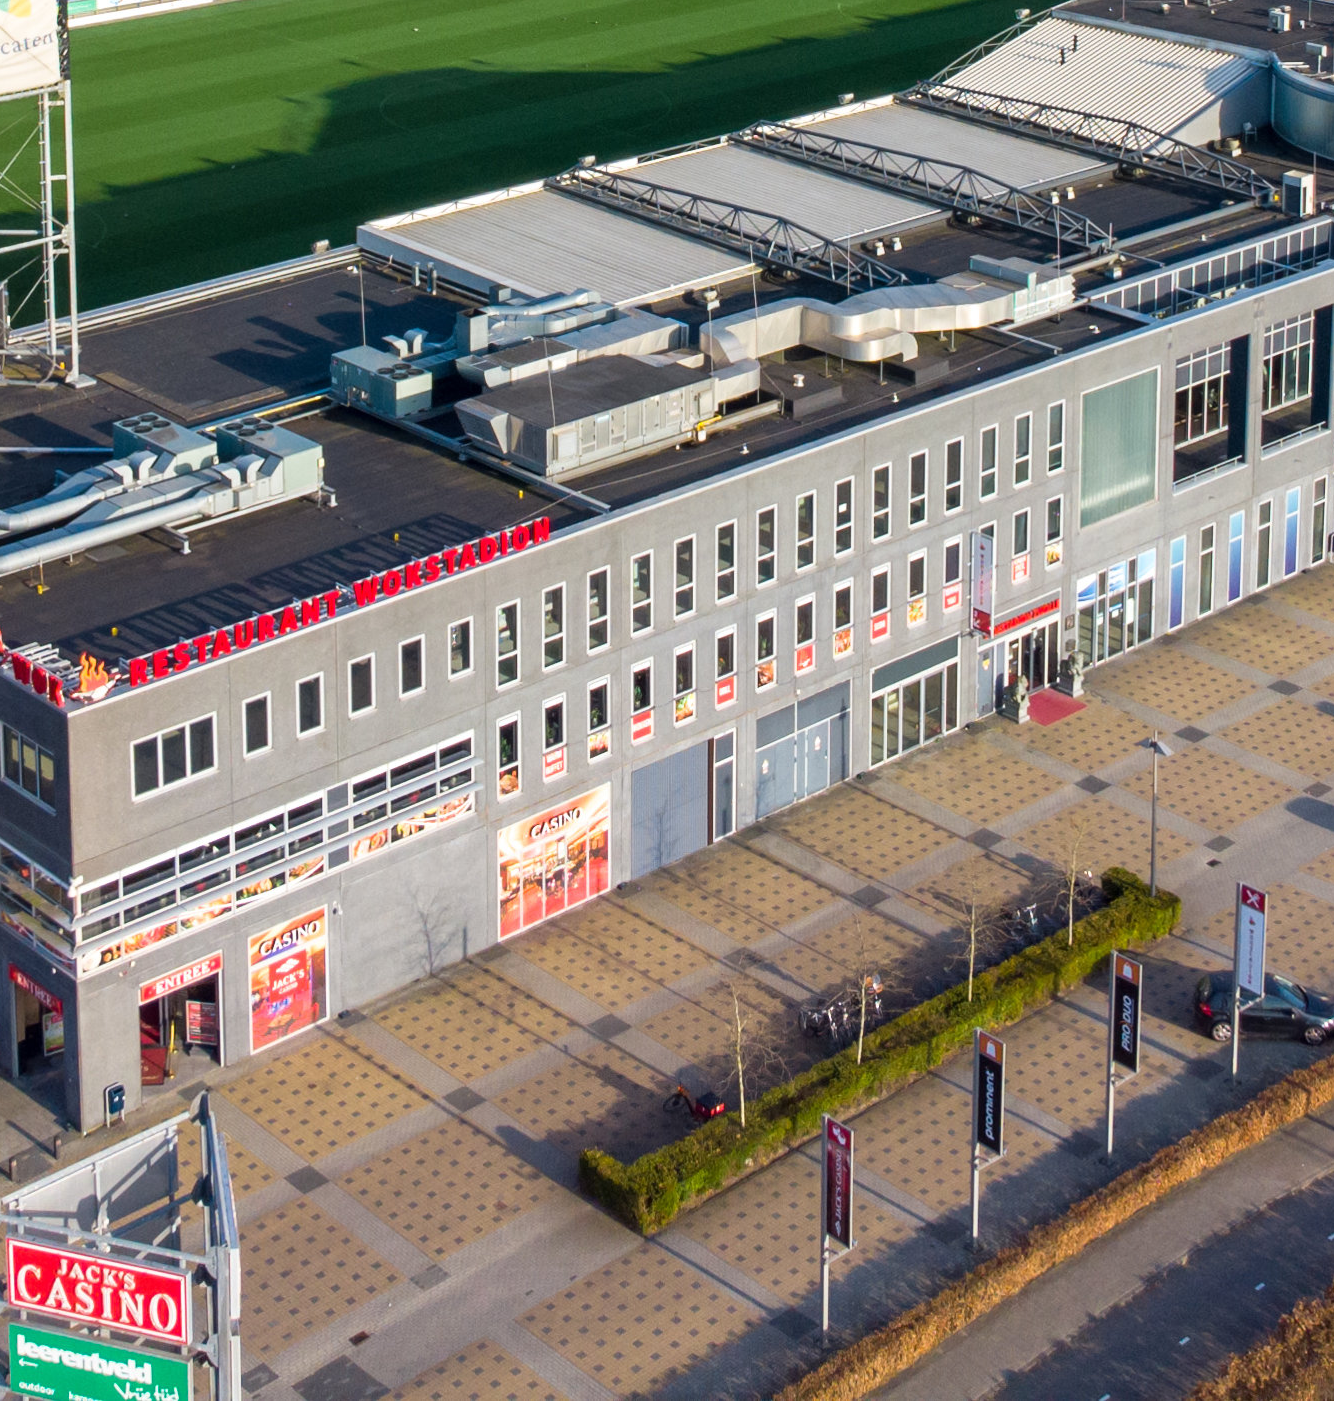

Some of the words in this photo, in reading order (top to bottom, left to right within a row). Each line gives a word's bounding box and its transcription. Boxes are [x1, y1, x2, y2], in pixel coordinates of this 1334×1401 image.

[130, 589, 342, 687] RESTAURANT
[353, 516, 550, 608] WOKSTADION
[11, 652, 66, 709] WOK
[530, 806, 583, 840] CASINO
[258, 919, 322, 958] CASINO
[17, 971, 52, 1010] ENTREE
[155, 960, 211, 995] ENTREE
[271, 969, 306, 992] JACK'S
[984, 1068, 995, 1141] prominent
[57, 1258, 136, 1292] JACK'S
[16, 1263, 178, 1333] CASINO
[16, 1333, 153, 1386] leerentveld
[18, 1380, 56, 1396] outdoor
